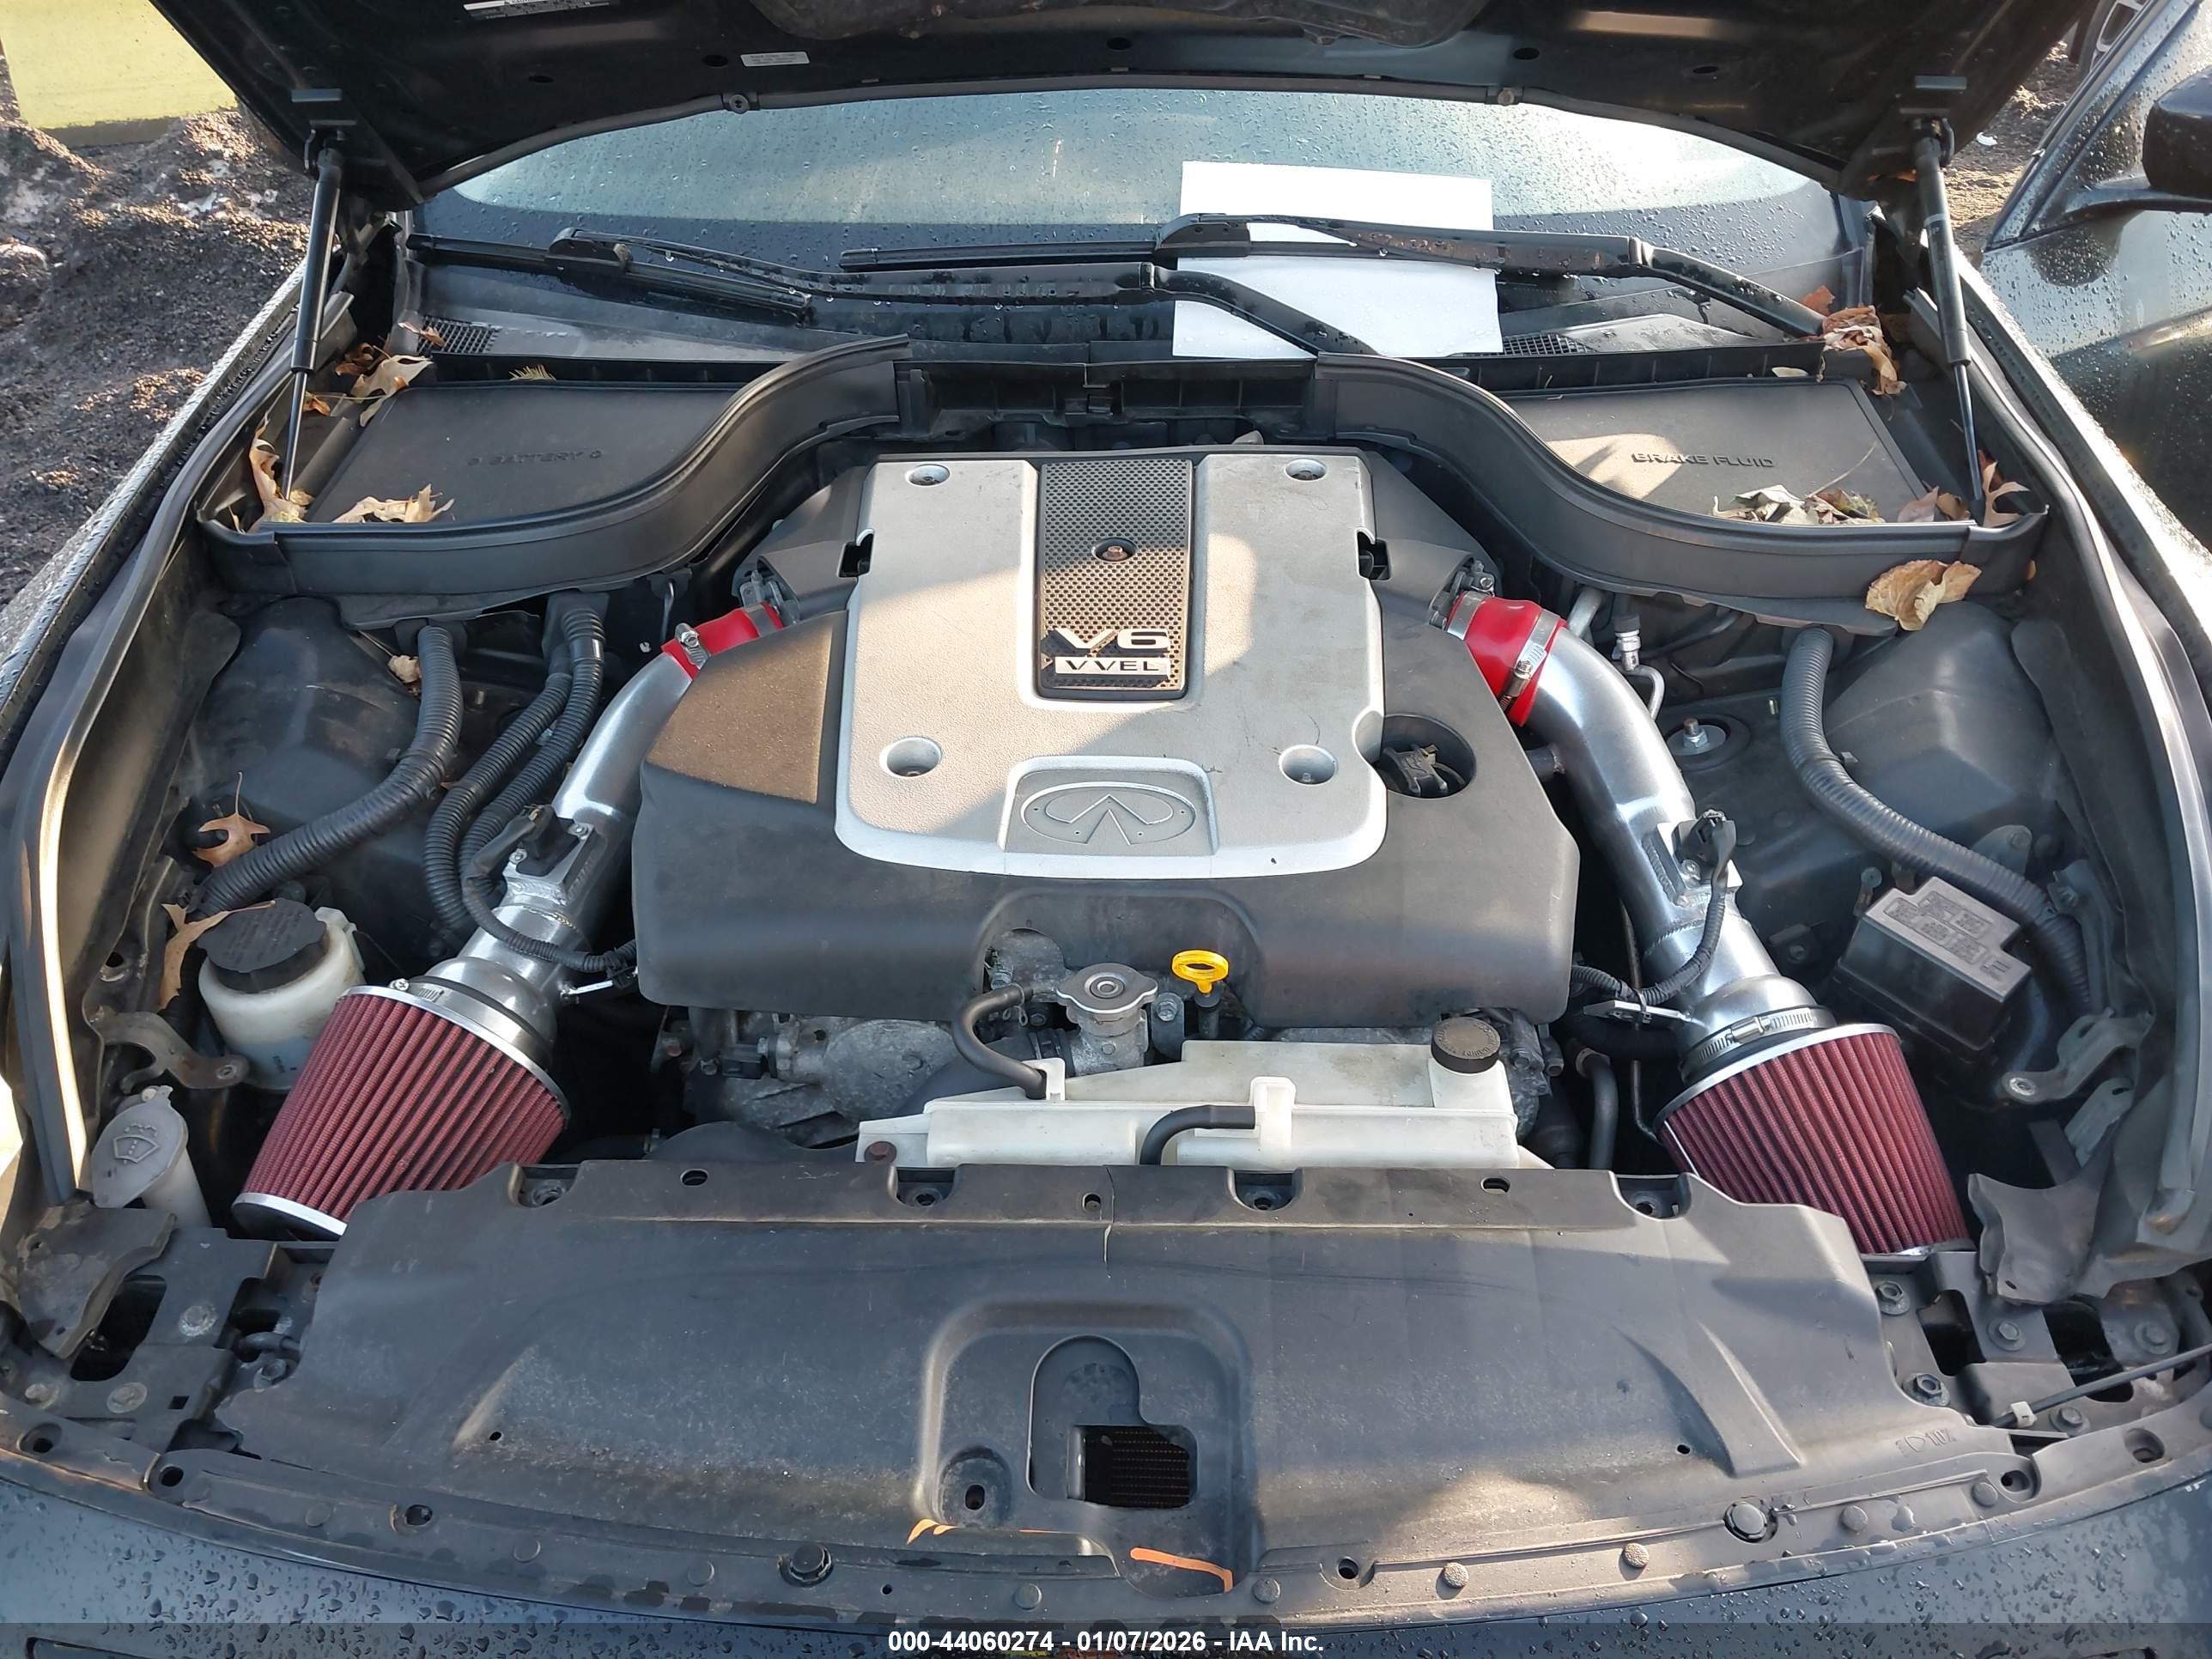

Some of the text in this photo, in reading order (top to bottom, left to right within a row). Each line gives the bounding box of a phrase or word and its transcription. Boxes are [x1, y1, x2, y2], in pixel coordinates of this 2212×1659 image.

[1630, 453, 1775, 468] BRAKE FLUID
[1051, 628, 1170, 650] V6
[1065, 659, 1159, 672] VVEL
